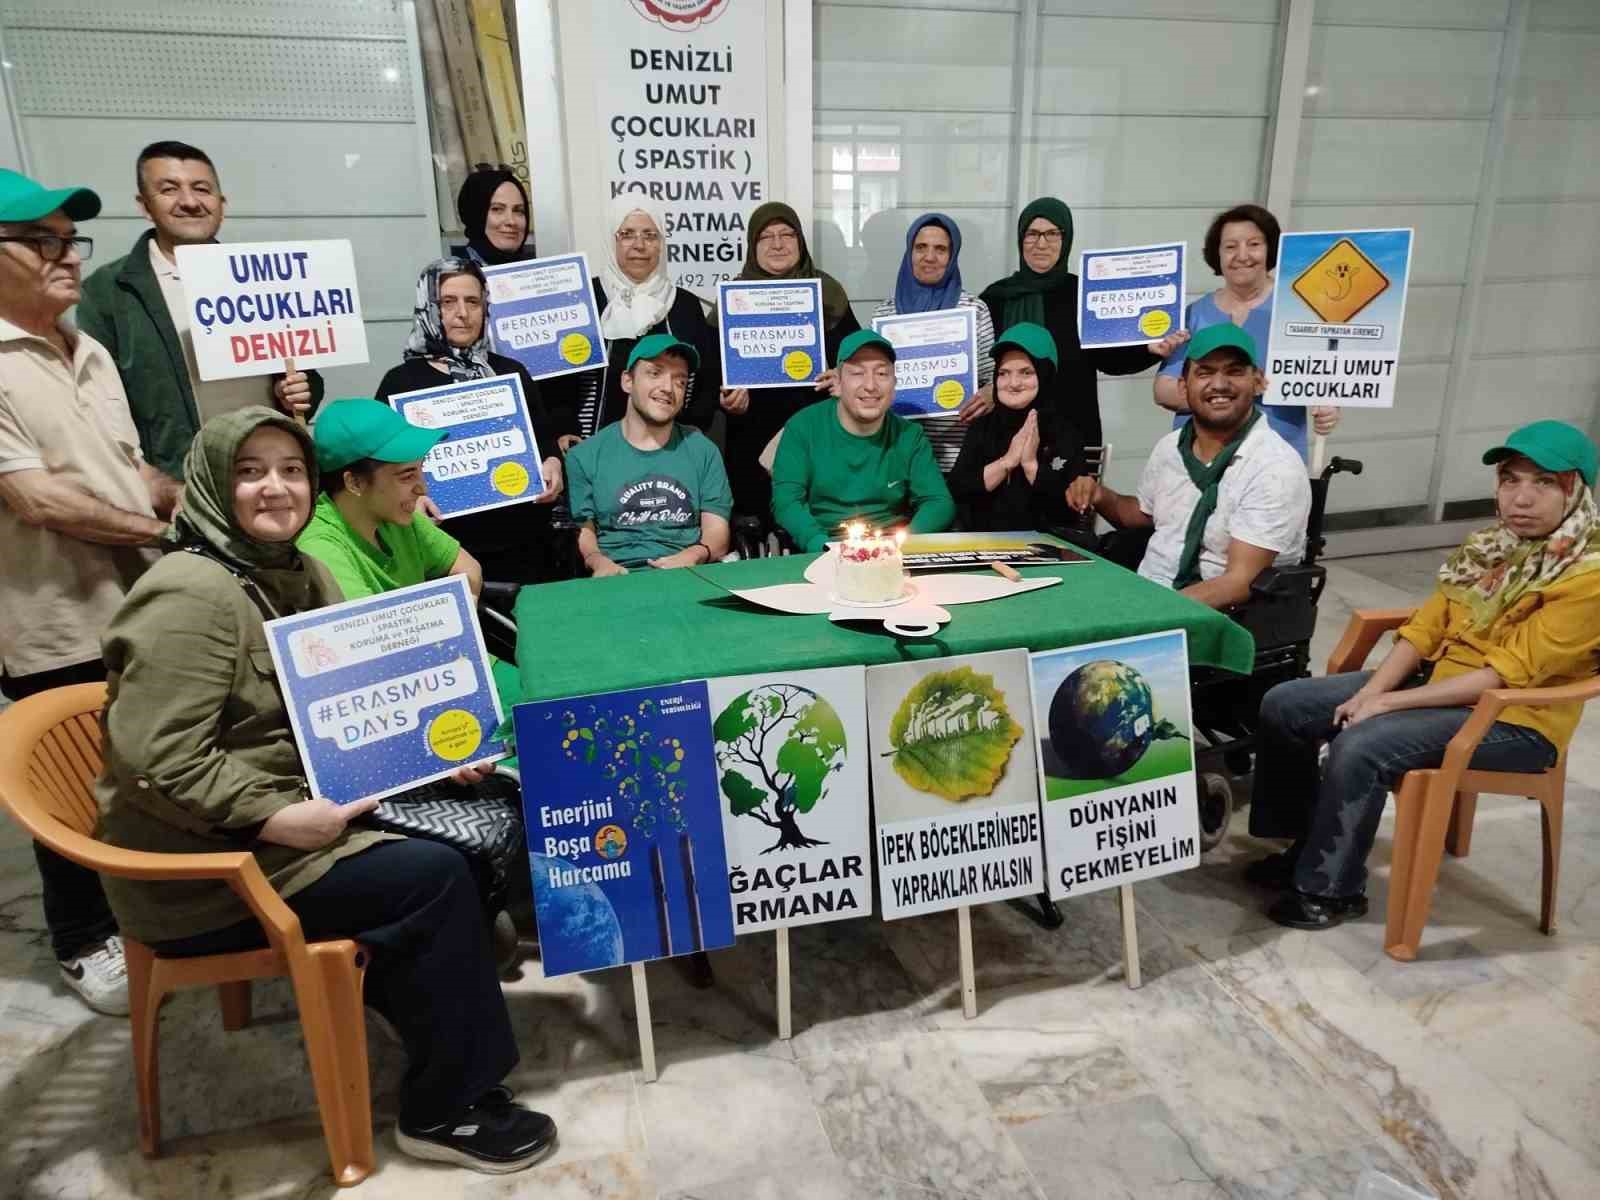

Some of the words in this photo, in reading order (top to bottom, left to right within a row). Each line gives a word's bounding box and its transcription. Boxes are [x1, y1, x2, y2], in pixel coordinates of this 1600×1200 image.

[630, 44, 733, 73] DENİZLİ
[646, 83, 721, 105] UMUT
[611, 116, 756, 142] ÇOCUKLARI
[635, 144, 736, 169] SPASTİK
[731, 181, 761, 200] VE
[665, 212, 745, 238] ŞATMA
[666, 237, 743, 262] RNEĞİ
[229, 252, 308, 283] UMUT
[1091, 290, 1166, 303] #ERASMUS
[195, 288, 354, 334] ÇOCUKLARI
[502, 309, 578, 331] #ERASMUS
[1100, 305, 1134, 316] DAYS
[230, 320, 337, 363] DENİZLİ
[515, 329, 551, 345] DAYS
[733, 329, 806, 341] #ERASMUS
[744, 344, 777, 353] DAYS
[896, 358, 958, 373] ERASMUS
[1272, 355, 1337, 376] DENİZLİ
[1344, 359, 1394, 376] UMUT
[1281, 382, 1380, 401] ÇOCUKLARI
[438, 458, 480, 477] DAYS
[620, 481, 654, 504] QUALITY
[656, 481, 687, 500] BRAND
[317, 669, 457, 724] #ERASMUS
[343, 710, 408, 744] DAYS
[540, 796, 613, 828] Enerjini
[1069, 786, 1177, 828] DÜNYANIN
[881, 828, 916, 866] İPEK
[919, 811, 1038, 860] BÖCEKLERİNEDE
[1096, 814, 1156, 851] FİŞİNİ
[544, 835, 591, 860] Boşa
[549, 860, 631, 888] Harcama
[728, 855, 863, 894] ĞAÇLAR
[1060, 836, 1194, 892] ÇEKMEYELİM
[892, 865, 978, 907] YAPRAKLAR
[982, 856, 1033, 893] KALSIN
[736, 888, 858, 925] RMANA
